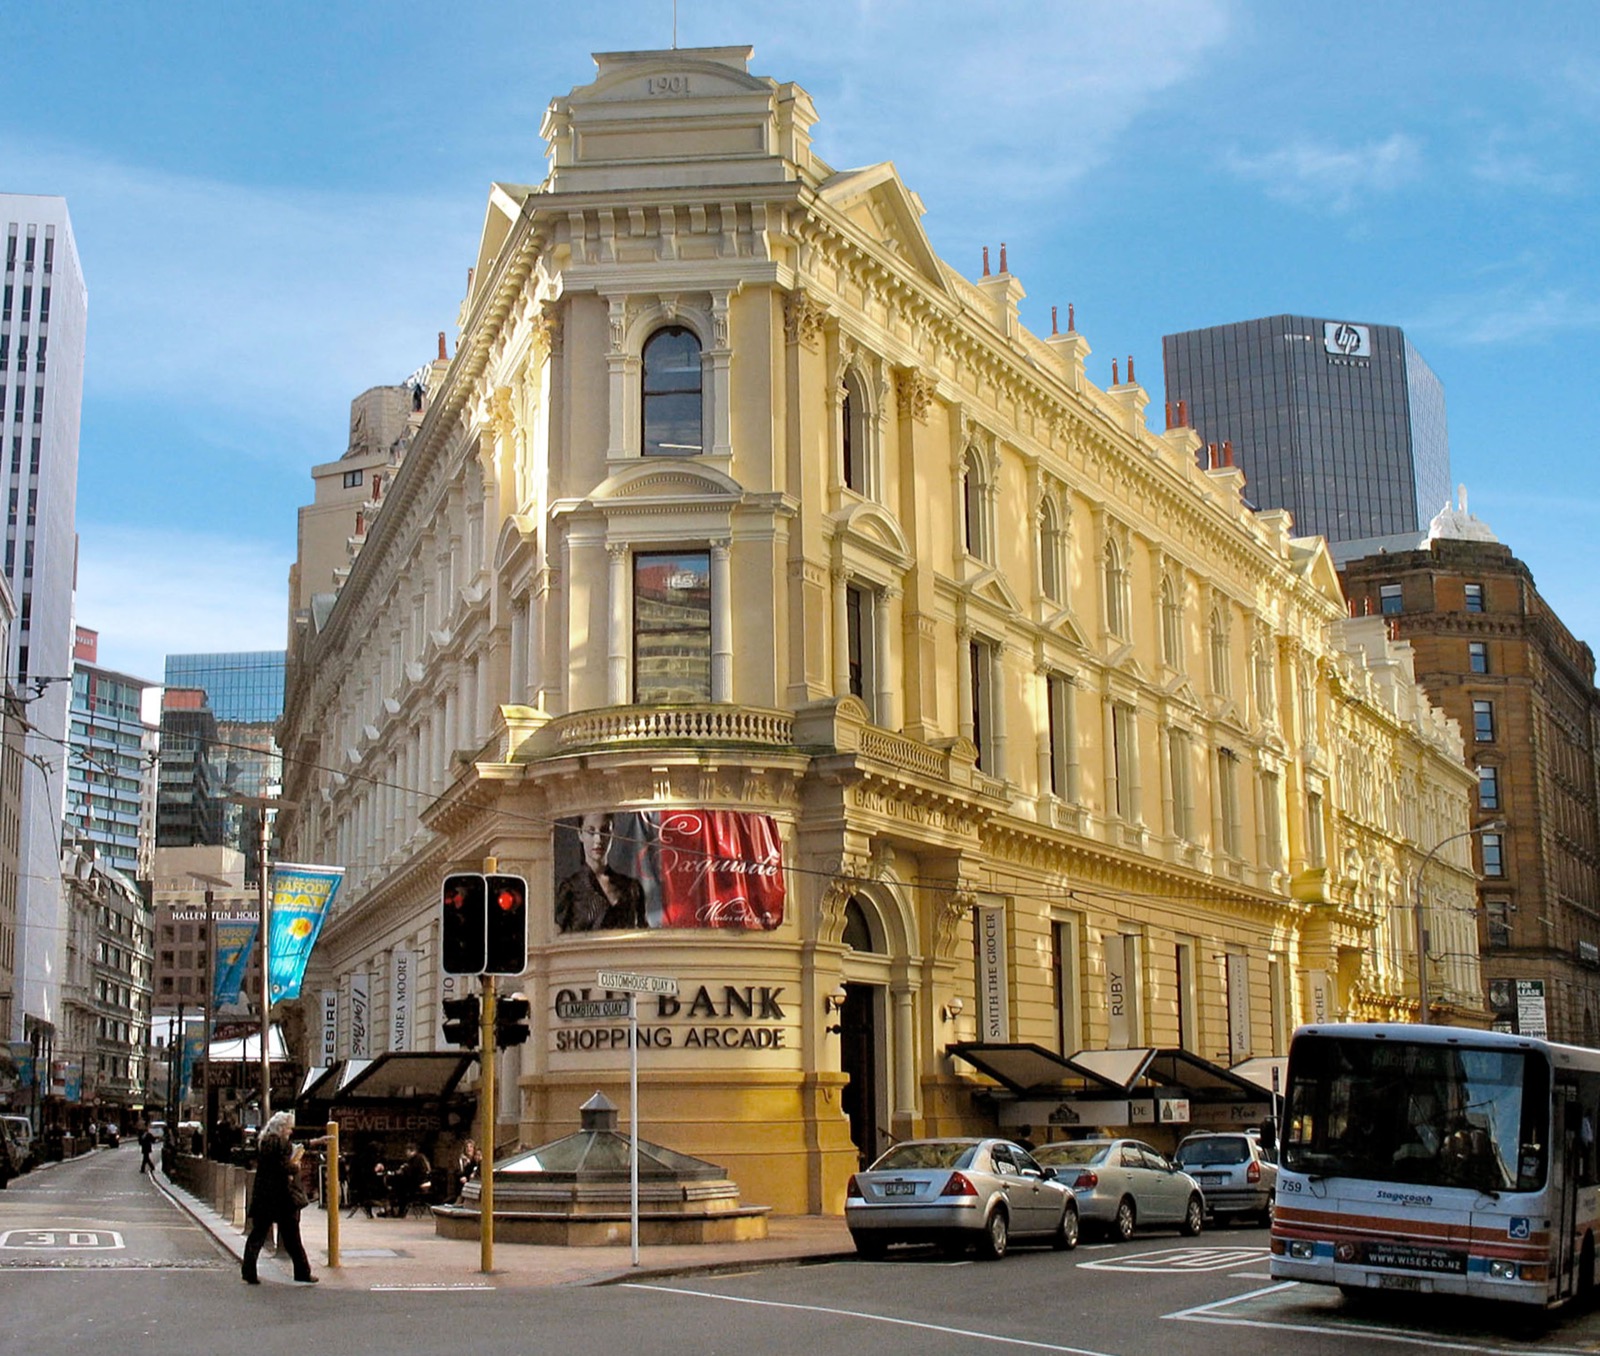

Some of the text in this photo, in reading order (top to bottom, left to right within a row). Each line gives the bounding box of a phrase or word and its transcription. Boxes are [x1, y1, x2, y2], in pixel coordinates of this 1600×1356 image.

[648, 77, 691, 95] 1901
[1337, 324, 1358, 355] hp
[172, 911, 261, 921] HALLENTEIN HOUS
[396, 957, 408, 1002] MOORE
[601, 973, 669, 991] CUSTOMHOUSE QUAY
[985, 913, 1001, 1038] SMITH THE GROCER
[1517, 981, 1533, 989] FOR
[1517, 988, 1541, 997] LEASE
[656, 985, 787, 1020] BANK
[1110, 972, 1125, 1017] RUBY
[565, 1002, 601, 1016] LAMBTON
[603, 1001, 623, 1015] QUAY
[324, 997, 336, 1068] DESIRE
[556, 1027, 786, 1051] SHOPPING ARCADE
[339, 1116, 442, 1131] JEWELLERS
[1282, 1180, 1302, 1193] 759
[1376, 1189, 1433, 1205] Stagecoach
[23, 1232, 99, 1246] 30
[1369, 1253, 1461, 1271] WWW.WISES.CO.NZ
